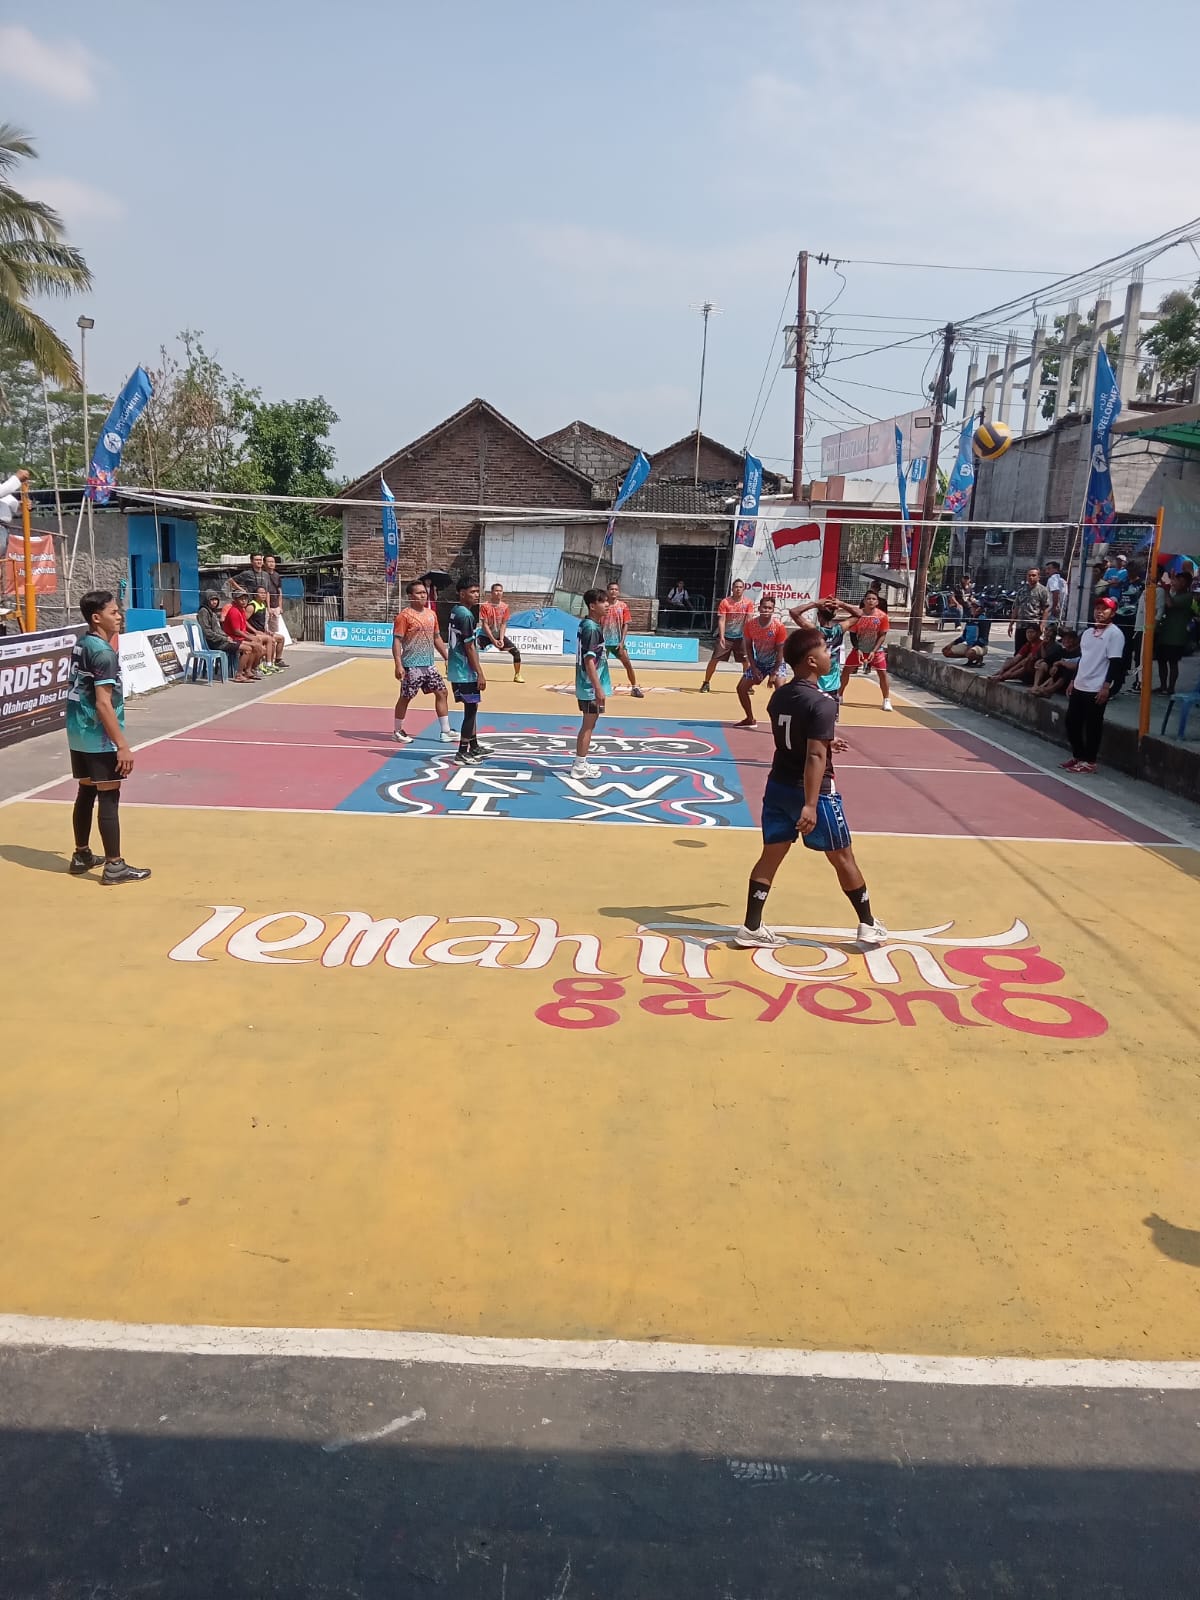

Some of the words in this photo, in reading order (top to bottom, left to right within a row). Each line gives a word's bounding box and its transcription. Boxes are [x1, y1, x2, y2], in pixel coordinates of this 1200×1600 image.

[762, 592, 811, 600] MERDEKA
[351, 627, 367, 635] SOS
[57, 657, 71, 683] 2
[3, 696, 38, 716] Olahraga
[778, 714, 793, 750] 7
